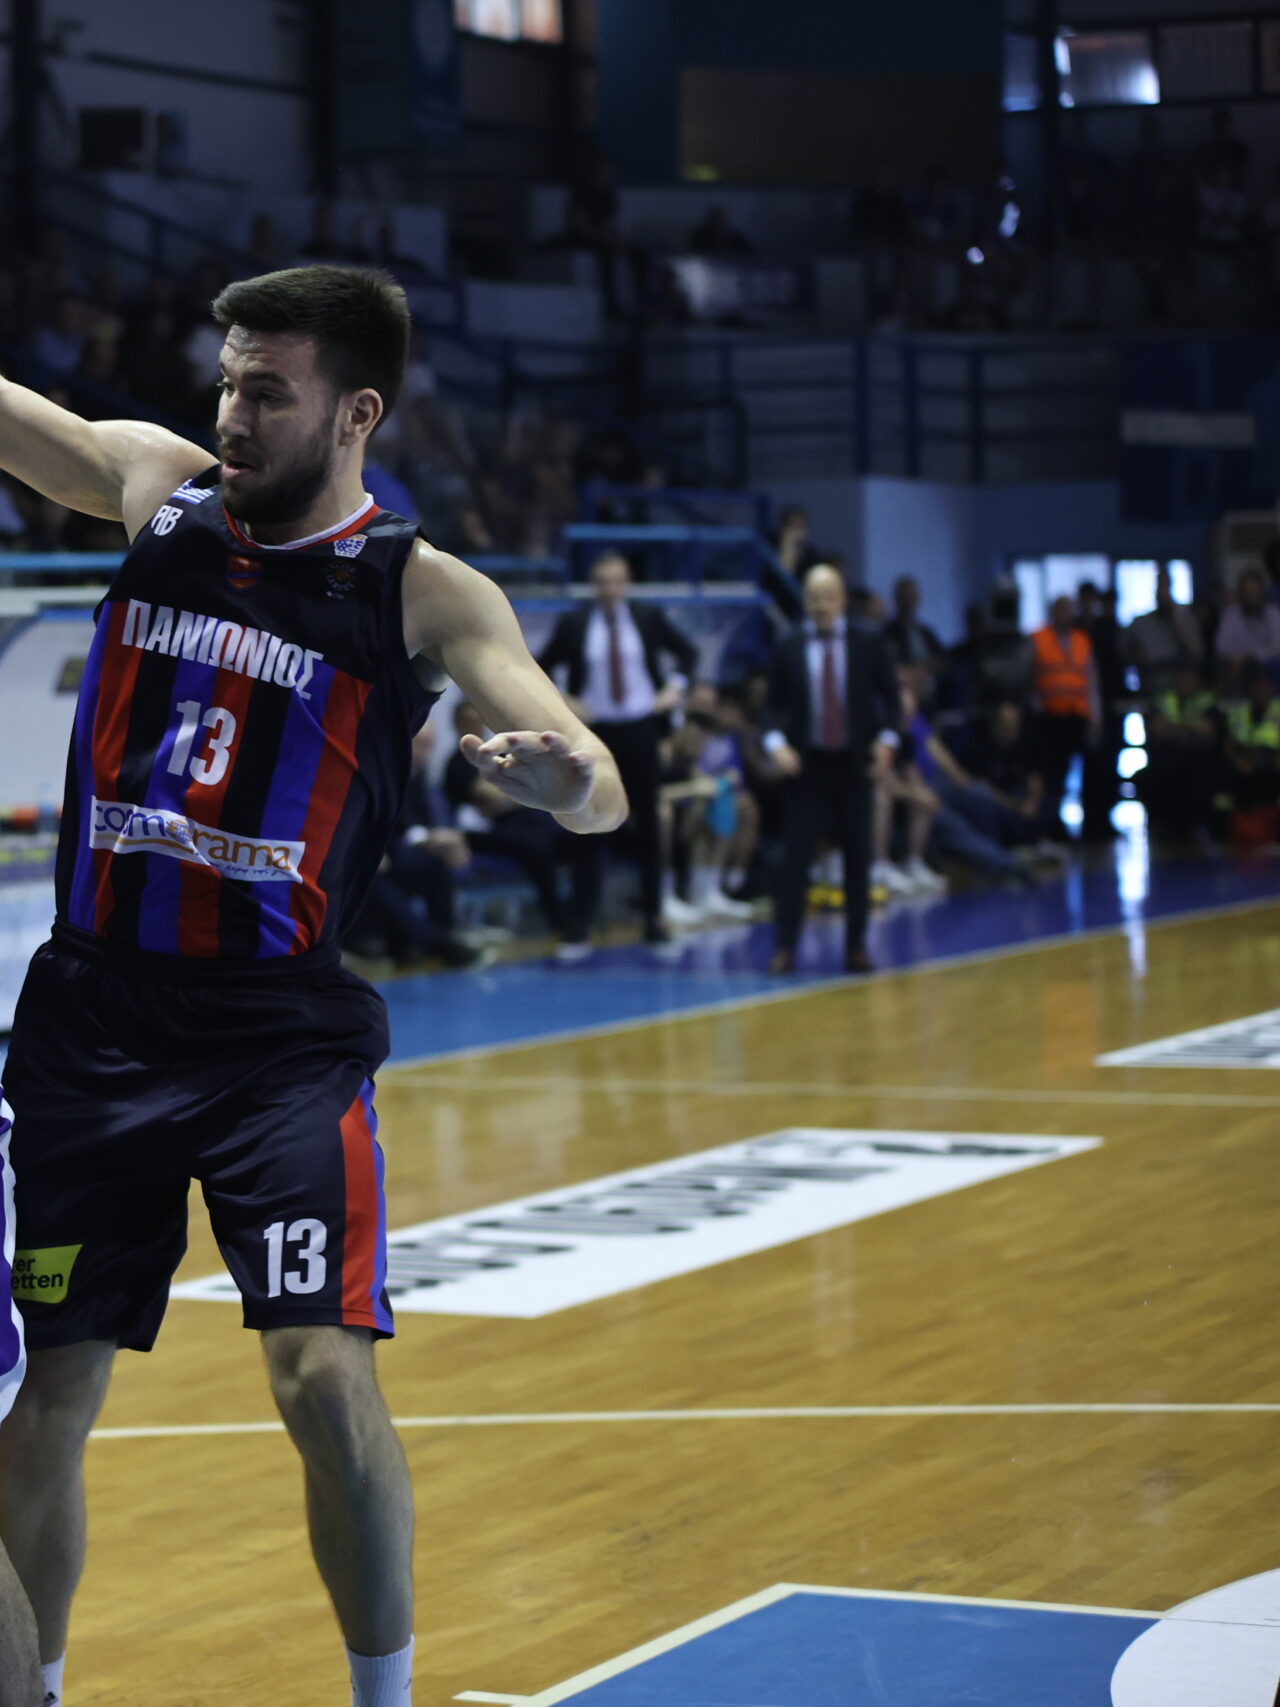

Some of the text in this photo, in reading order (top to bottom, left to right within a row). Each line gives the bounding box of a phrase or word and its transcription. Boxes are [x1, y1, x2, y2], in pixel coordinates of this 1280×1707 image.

[121, 599, 324, 701] ΠΑΝΙΩΝΙΟΣ
[166, 700, 237, 786] 13
[12, 1272, 64, 1290] etten
[14, 1258, 35, 1272] er
[263, 1218, 327, 1298] 13
